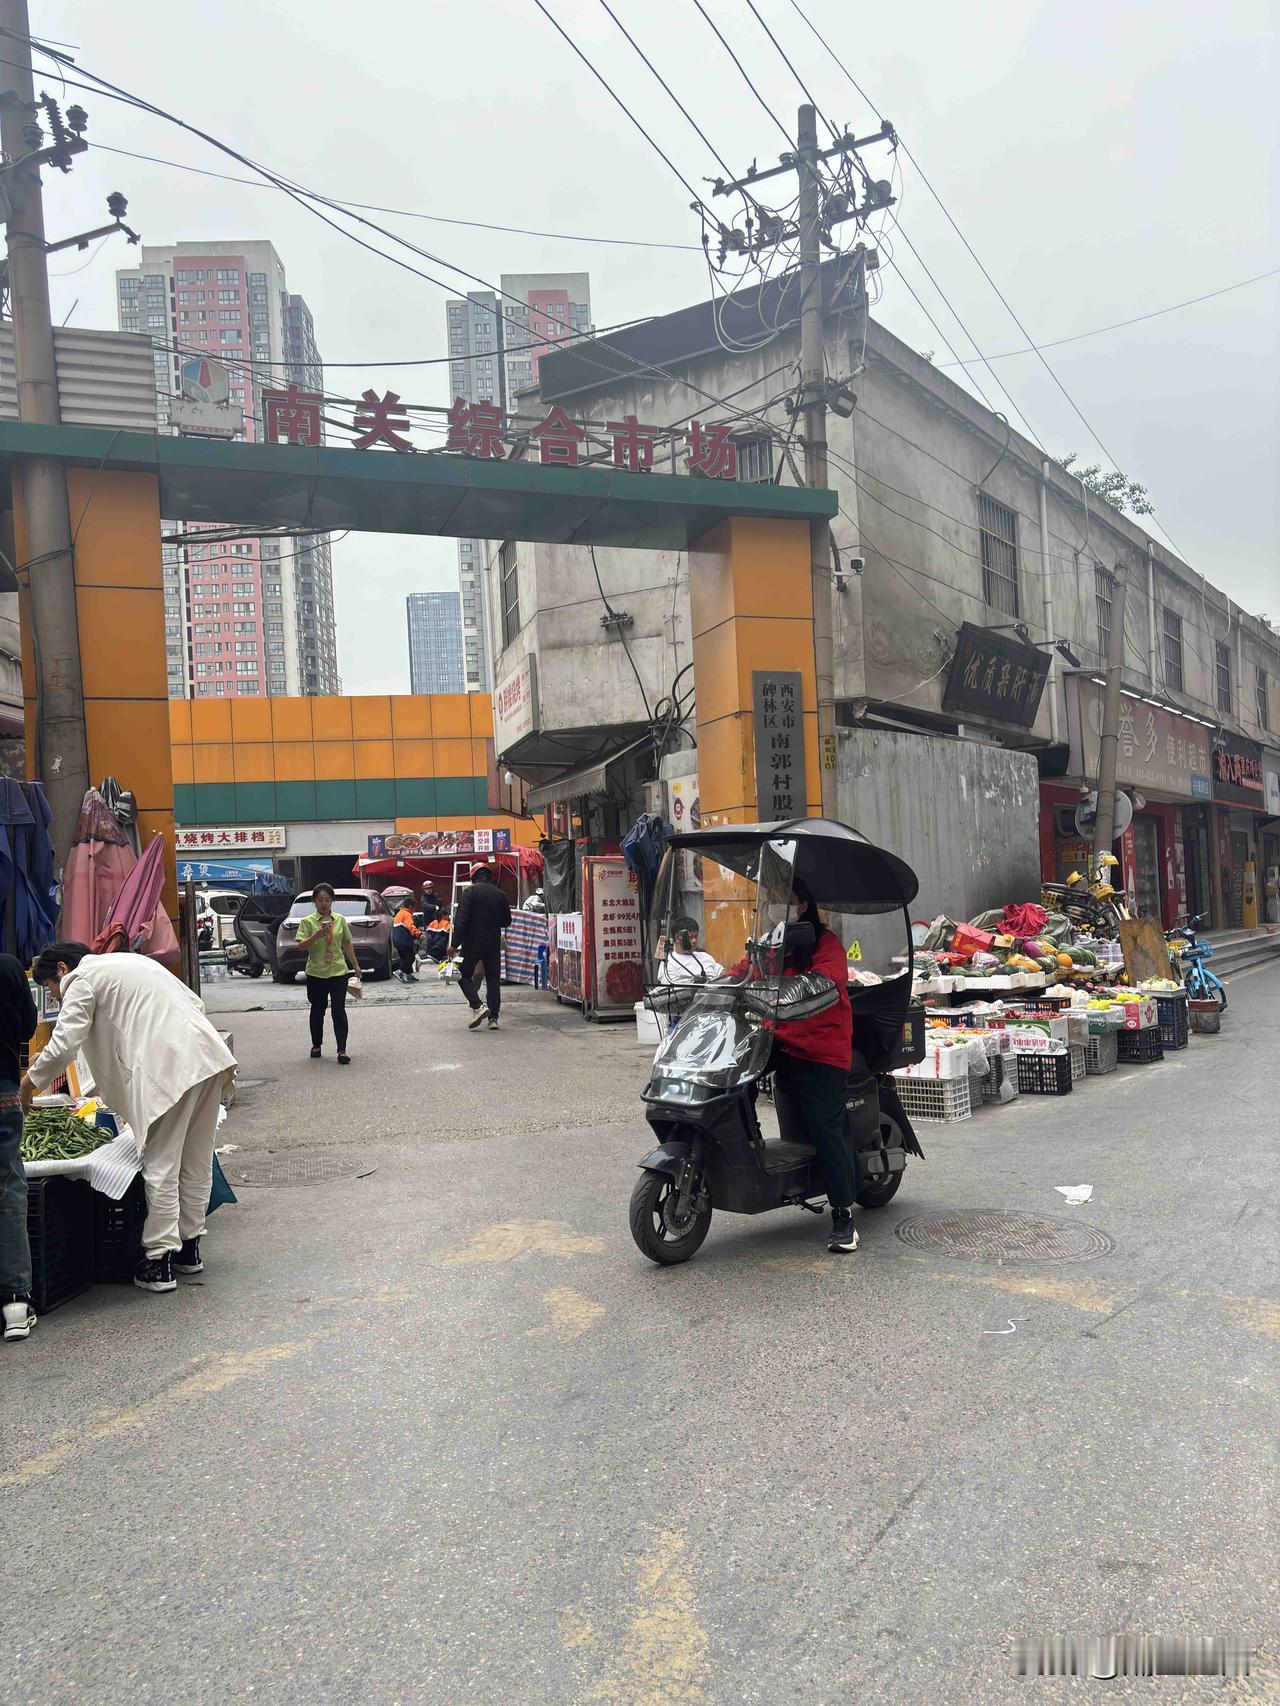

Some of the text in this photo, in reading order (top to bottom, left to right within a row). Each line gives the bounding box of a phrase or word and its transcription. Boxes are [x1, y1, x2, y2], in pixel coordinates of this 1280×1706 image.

[261, 384, 737, 479] 南关综合市场
[762, 681, 778, 728] 碑林区
[781, 683, 796, 729] 西安市
[1166, 734, 1207, 772] 便利超市
[602, 913, 616, 921] 龙虾
